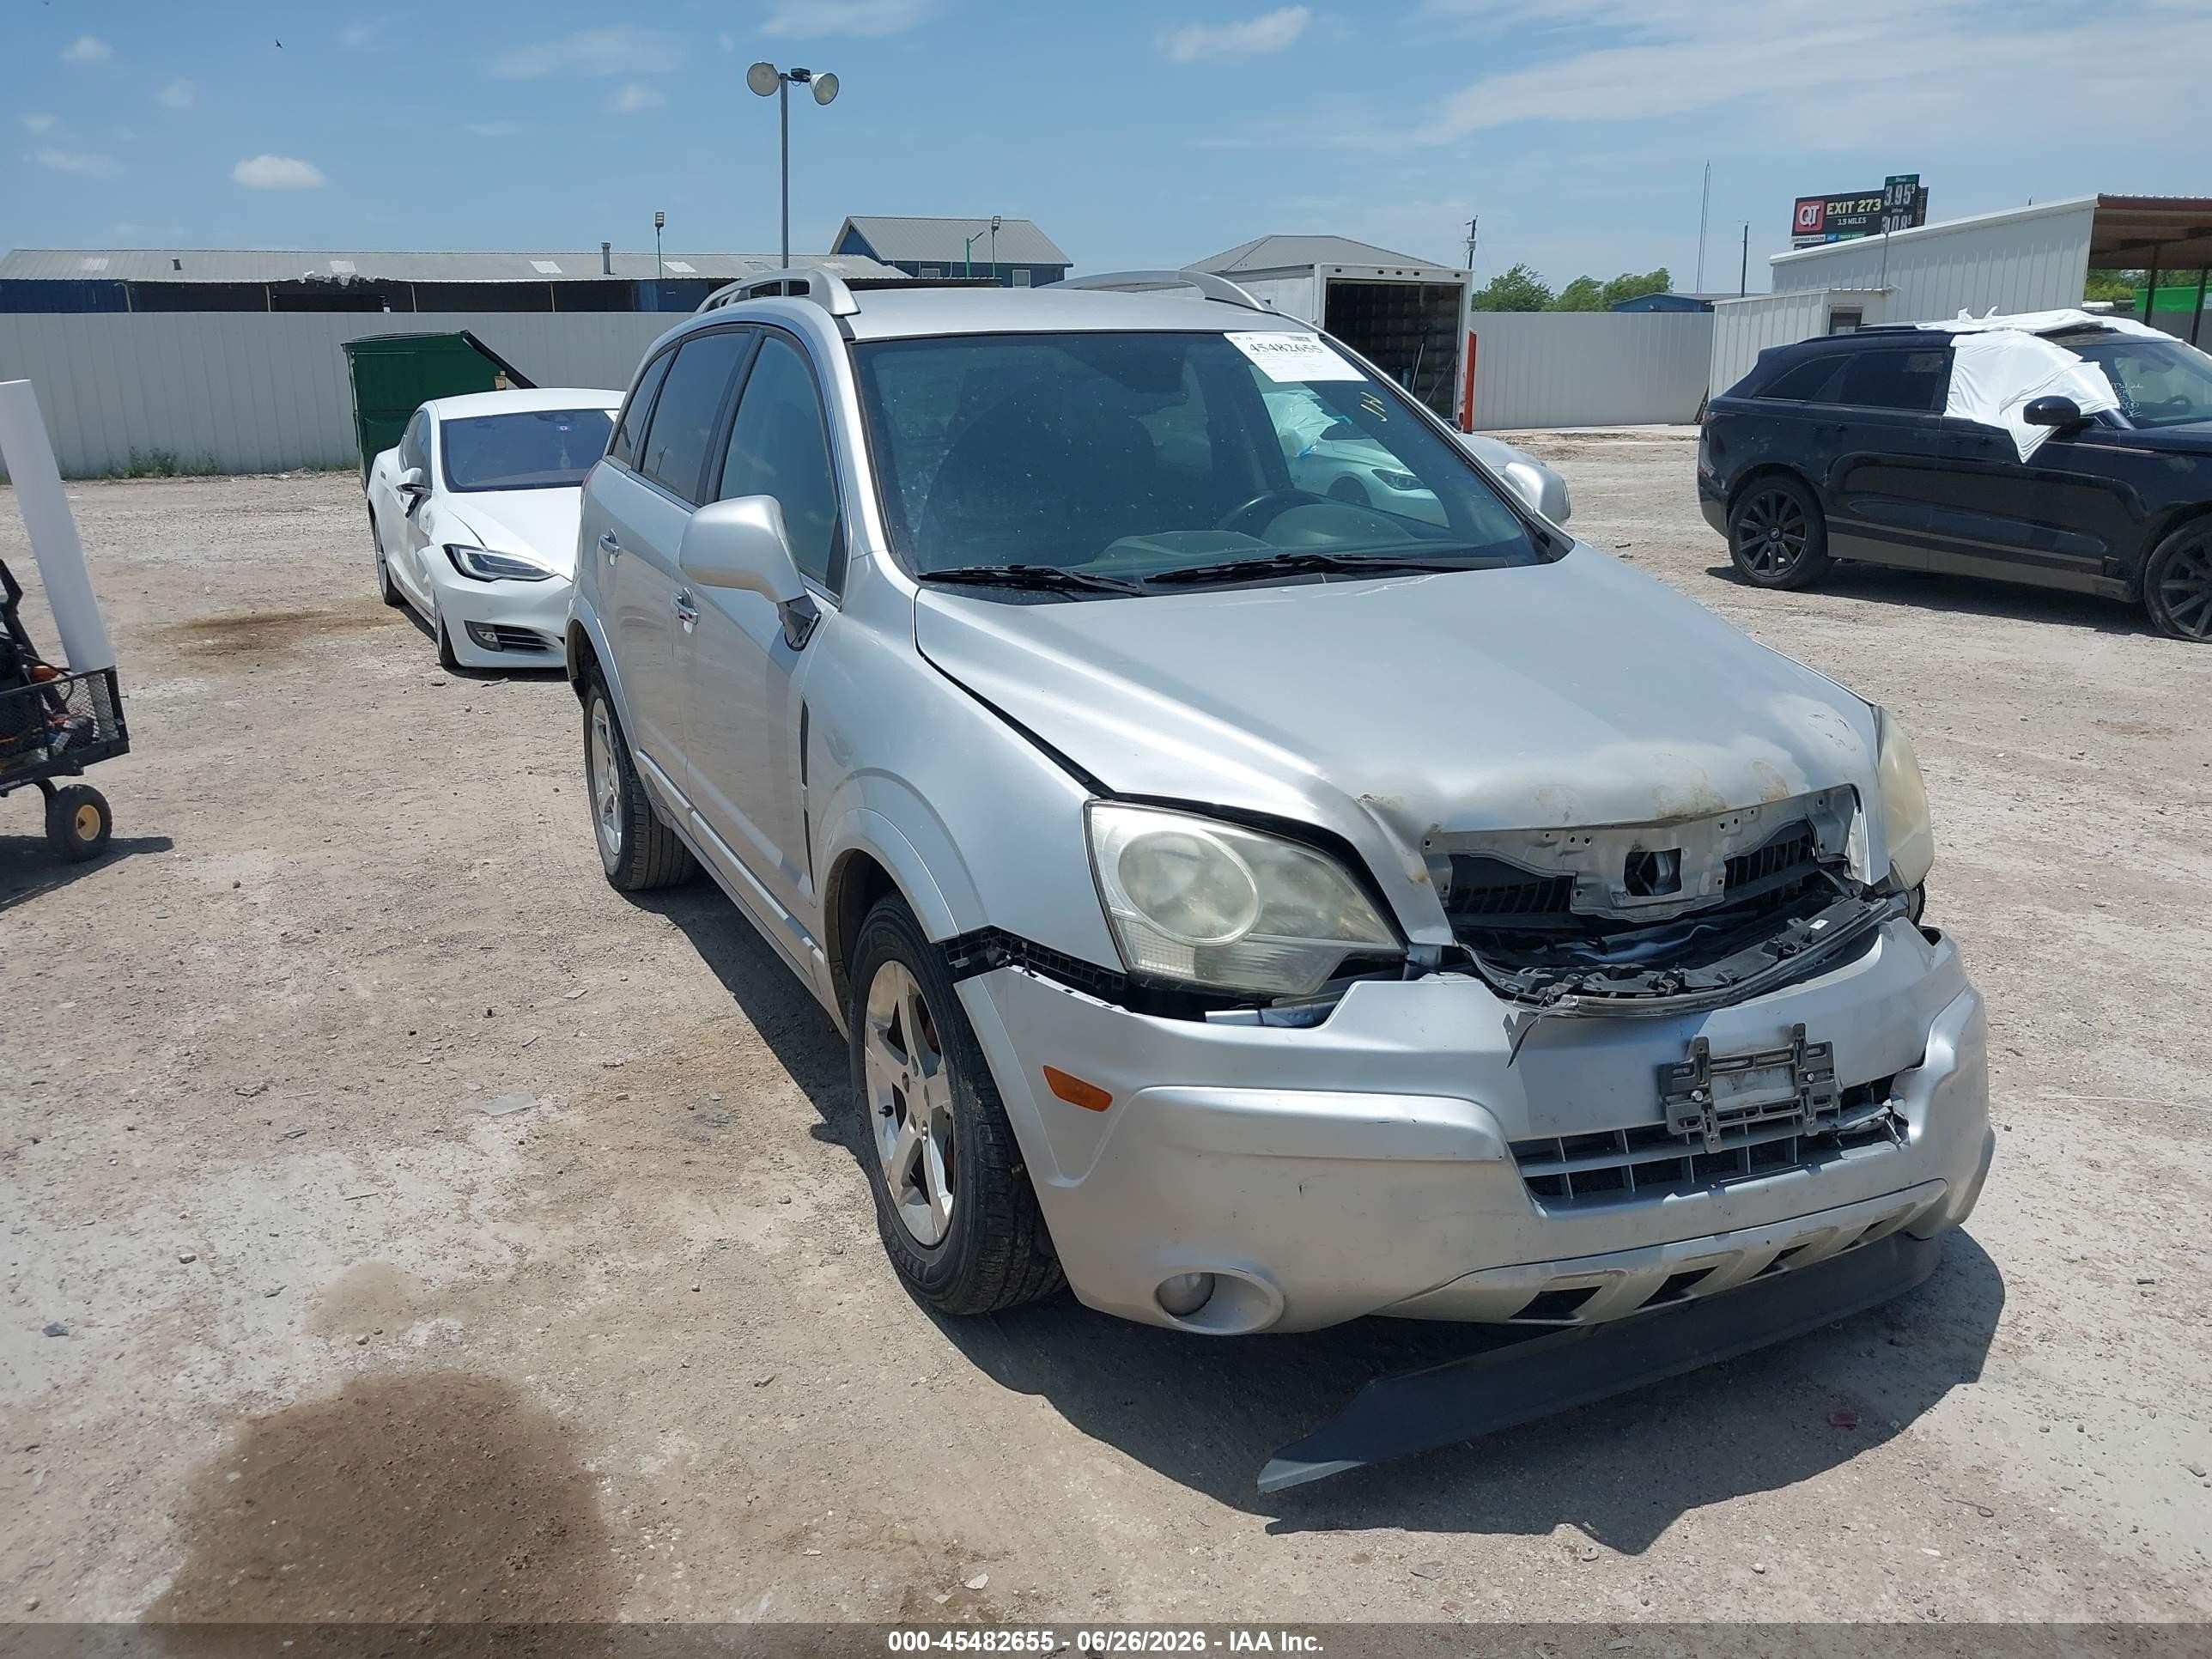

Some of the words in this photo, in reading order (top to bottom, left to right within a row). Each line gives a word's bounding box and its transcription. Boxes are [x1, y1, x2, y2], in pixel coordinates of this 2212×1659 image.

[1826, 201, 1856, 216] EXIT
[1856, 198, 1881, 212] 273
[1799, 205, 1820, 227] QT
[1847, 216, 1867, 225] MILES
[1249, 343, 1324, 354] 45482655
